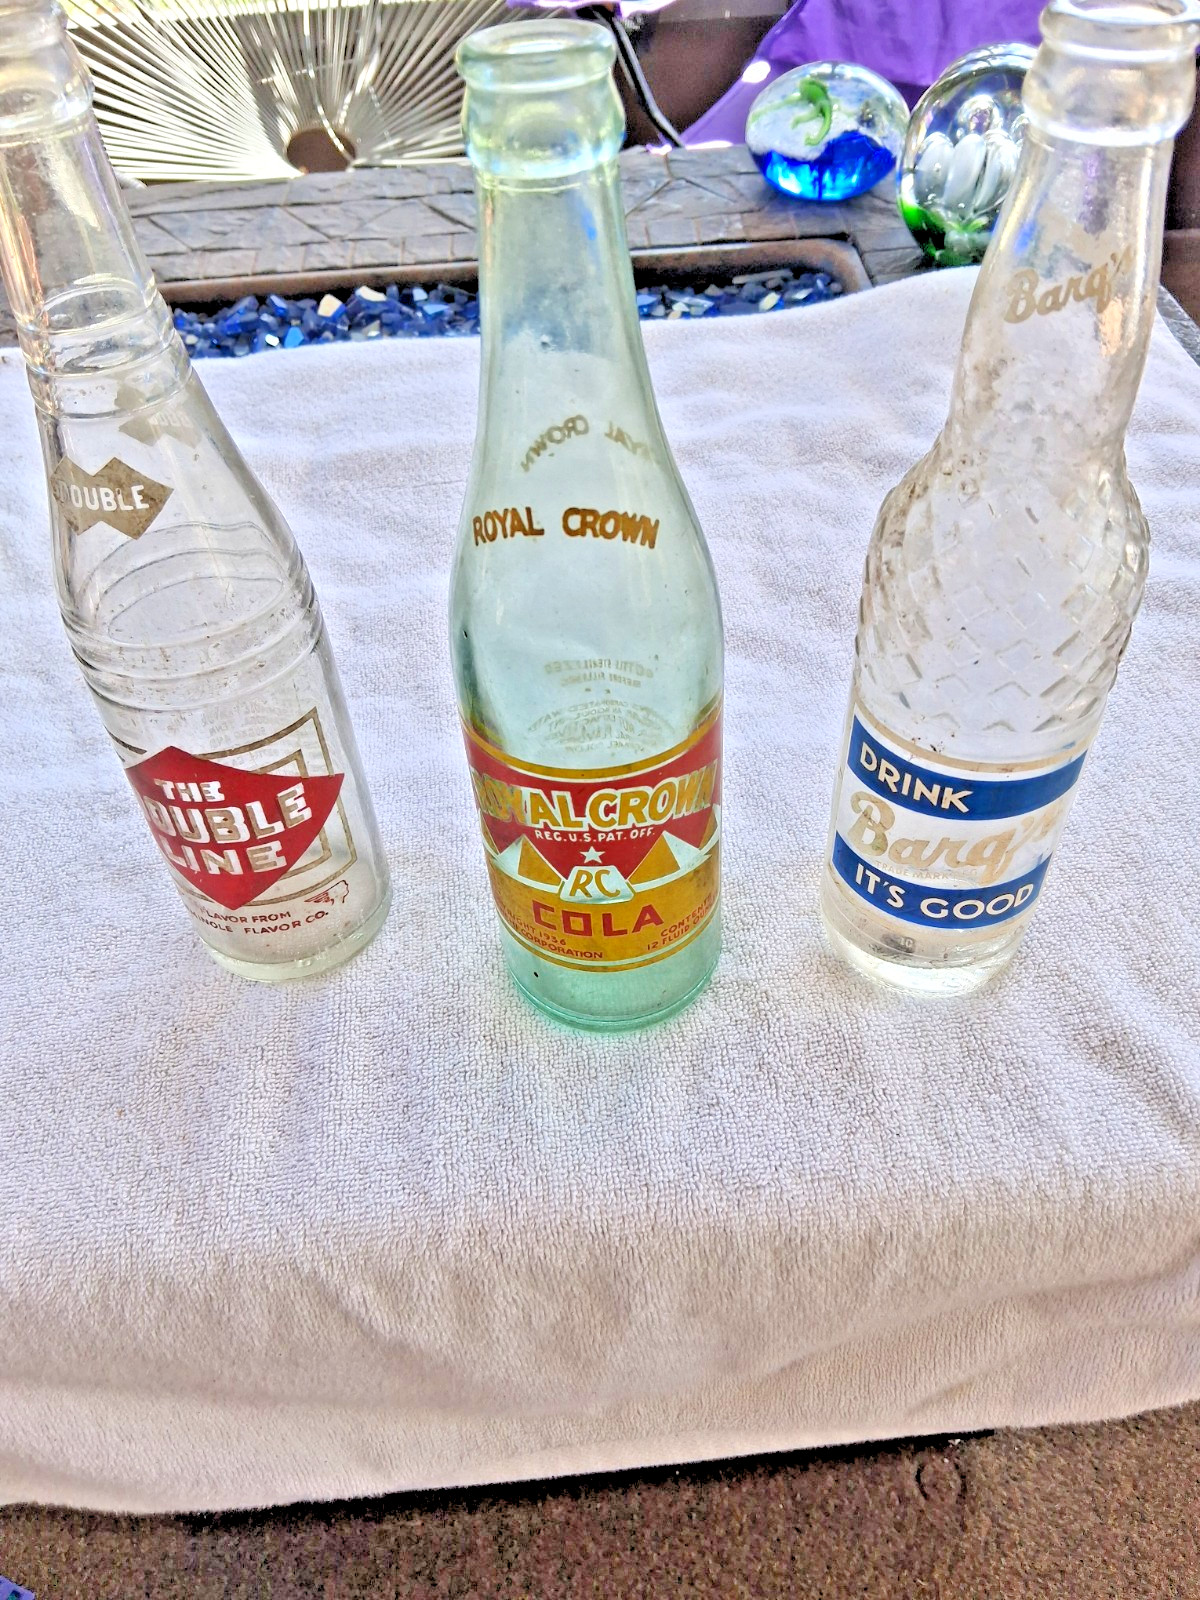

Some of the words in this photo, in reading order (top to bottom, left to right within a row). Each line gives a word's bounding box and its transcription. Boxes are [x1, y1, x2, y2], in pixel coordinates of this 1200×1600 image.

[473, 506, 545, 546] ROYAL
[562, 507, 660, 549] CROWN
[154, 778, 226, 803] THE
[587, 757, 718, 830] CROWN
[859, 741, 973, 813] DRINK
[143, 782, 313, 844] OUBLE
[158, 834, 288, 875] LINE
[849, 790, 1061, 885] Barg's
[570, 869, 622, 899] RC
[855, 863, 905, 908] IT'S
[919, 883, 1035, 920] GOOD
[244, 920, 302, 934] FLAVOR
[305, 910, 329, 924] CO.
[251, 911, 291, 923] FROM
[532, 899, 664, 937] COLA
[521, 928, 603, 959] CORPORATION
[647, 941, 659, 951] 12
[662, 924, 690, 945] FLUID
